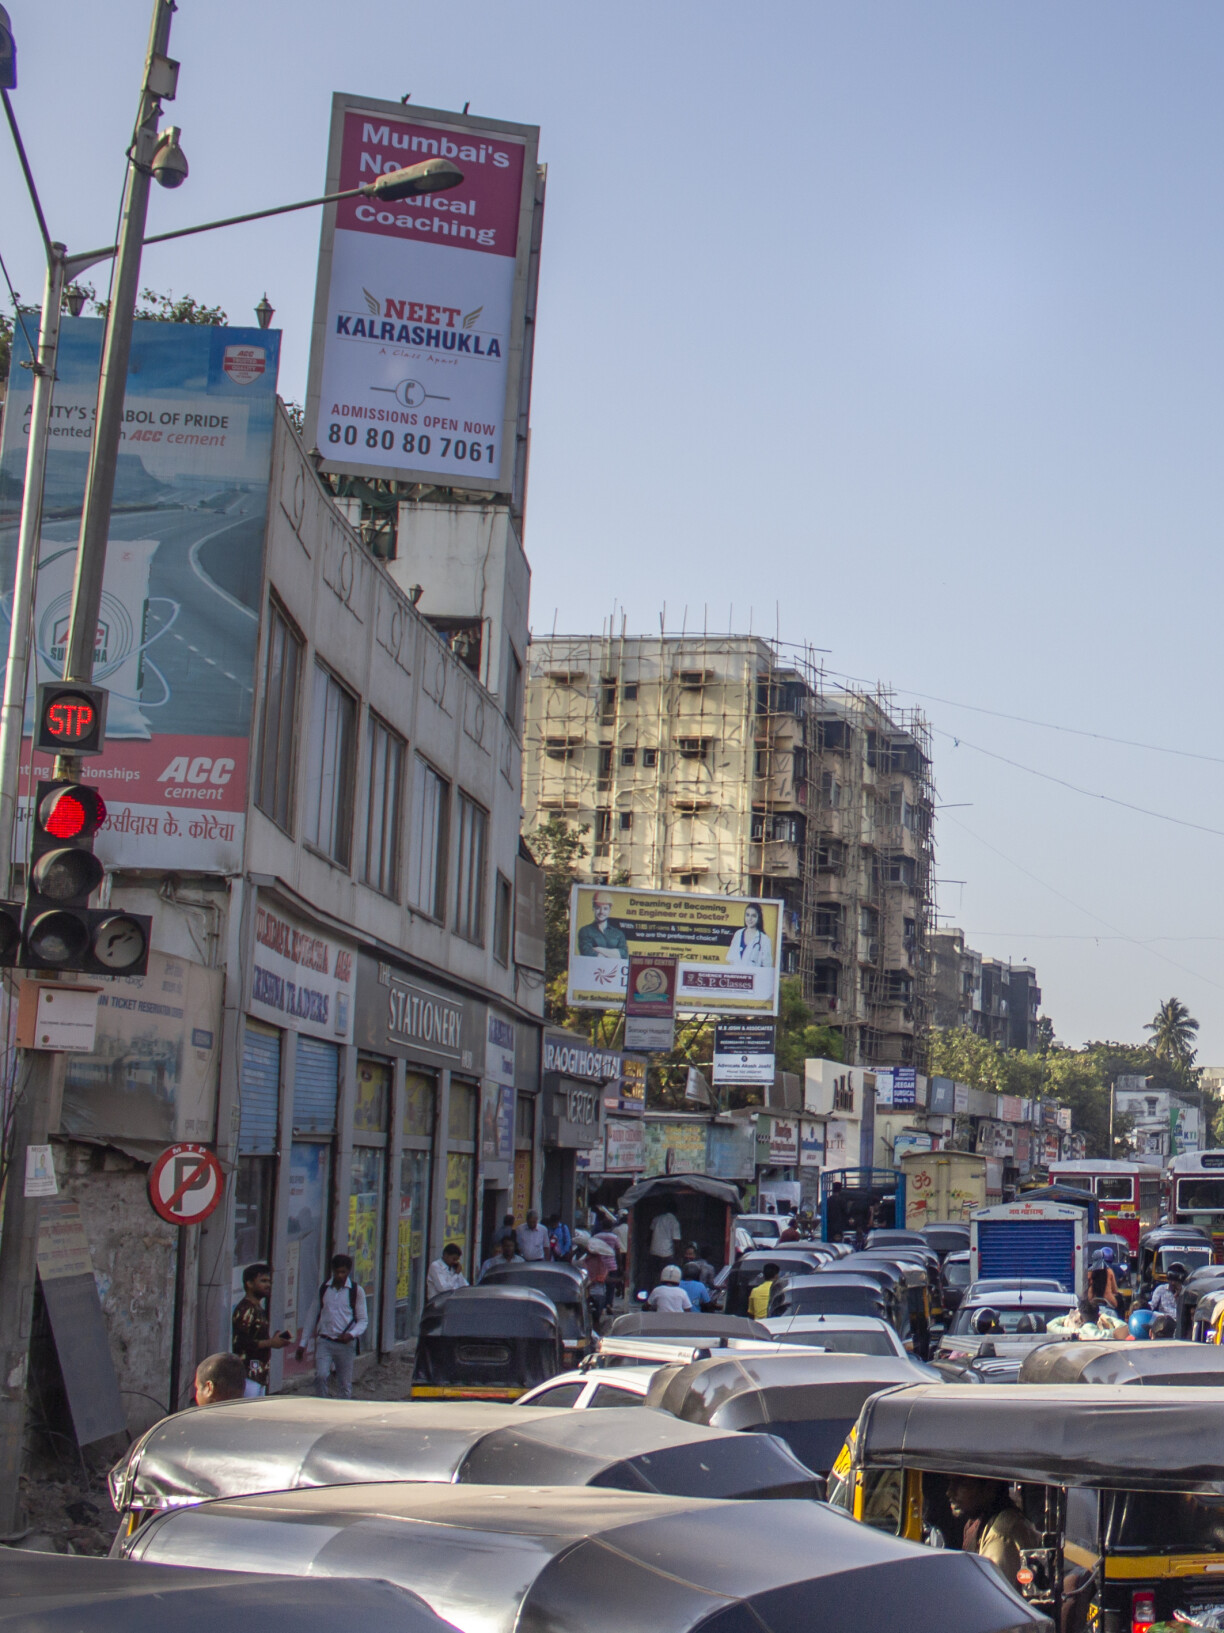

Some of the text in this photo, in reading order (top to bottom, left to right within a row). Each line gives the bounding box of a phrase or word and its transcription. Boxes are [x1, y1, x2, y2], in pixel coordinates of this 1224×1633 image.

[362, 122, 510, 168] Mumbai's
[355, 204, 497, 247] Coaching
[384, 297, 461, 328] NEET
[336, 314, 502, 358] KALRASHUKLA
[45, 405, 88, 420] ITY'S
[160, 412, 181, 425] OF
[184, 415, 229, 429] PRIDE
[331, 403, 496, 436] ADMISSIONS OPEN NOW
[129, 429, 164, 443] ACC
[167, 432, 227, 447] cement
[328, 423, 495, 464] 80 80 80 7061
[49, 704, 92, 736] STP
[157, 756, 235, 785] ACC
[164, 785, 224, 800] cement
[626, 908, 637, 916] an
[639, 908, 678, 919] Engineer
[696, 911, 730, 921] Doctor?
[629, 899, 727, 913] Dreaming of Becoming
[667, 932, 695, 941] preferred
[703, 954, 720, 962] NATA
[719, 978, 752, 989] Classes
[111, 996, 138, 1012] TICKET
[388, 988, 463, 1049] STATIONERY
[894, 1081, 915, 1089] JEEGAR
